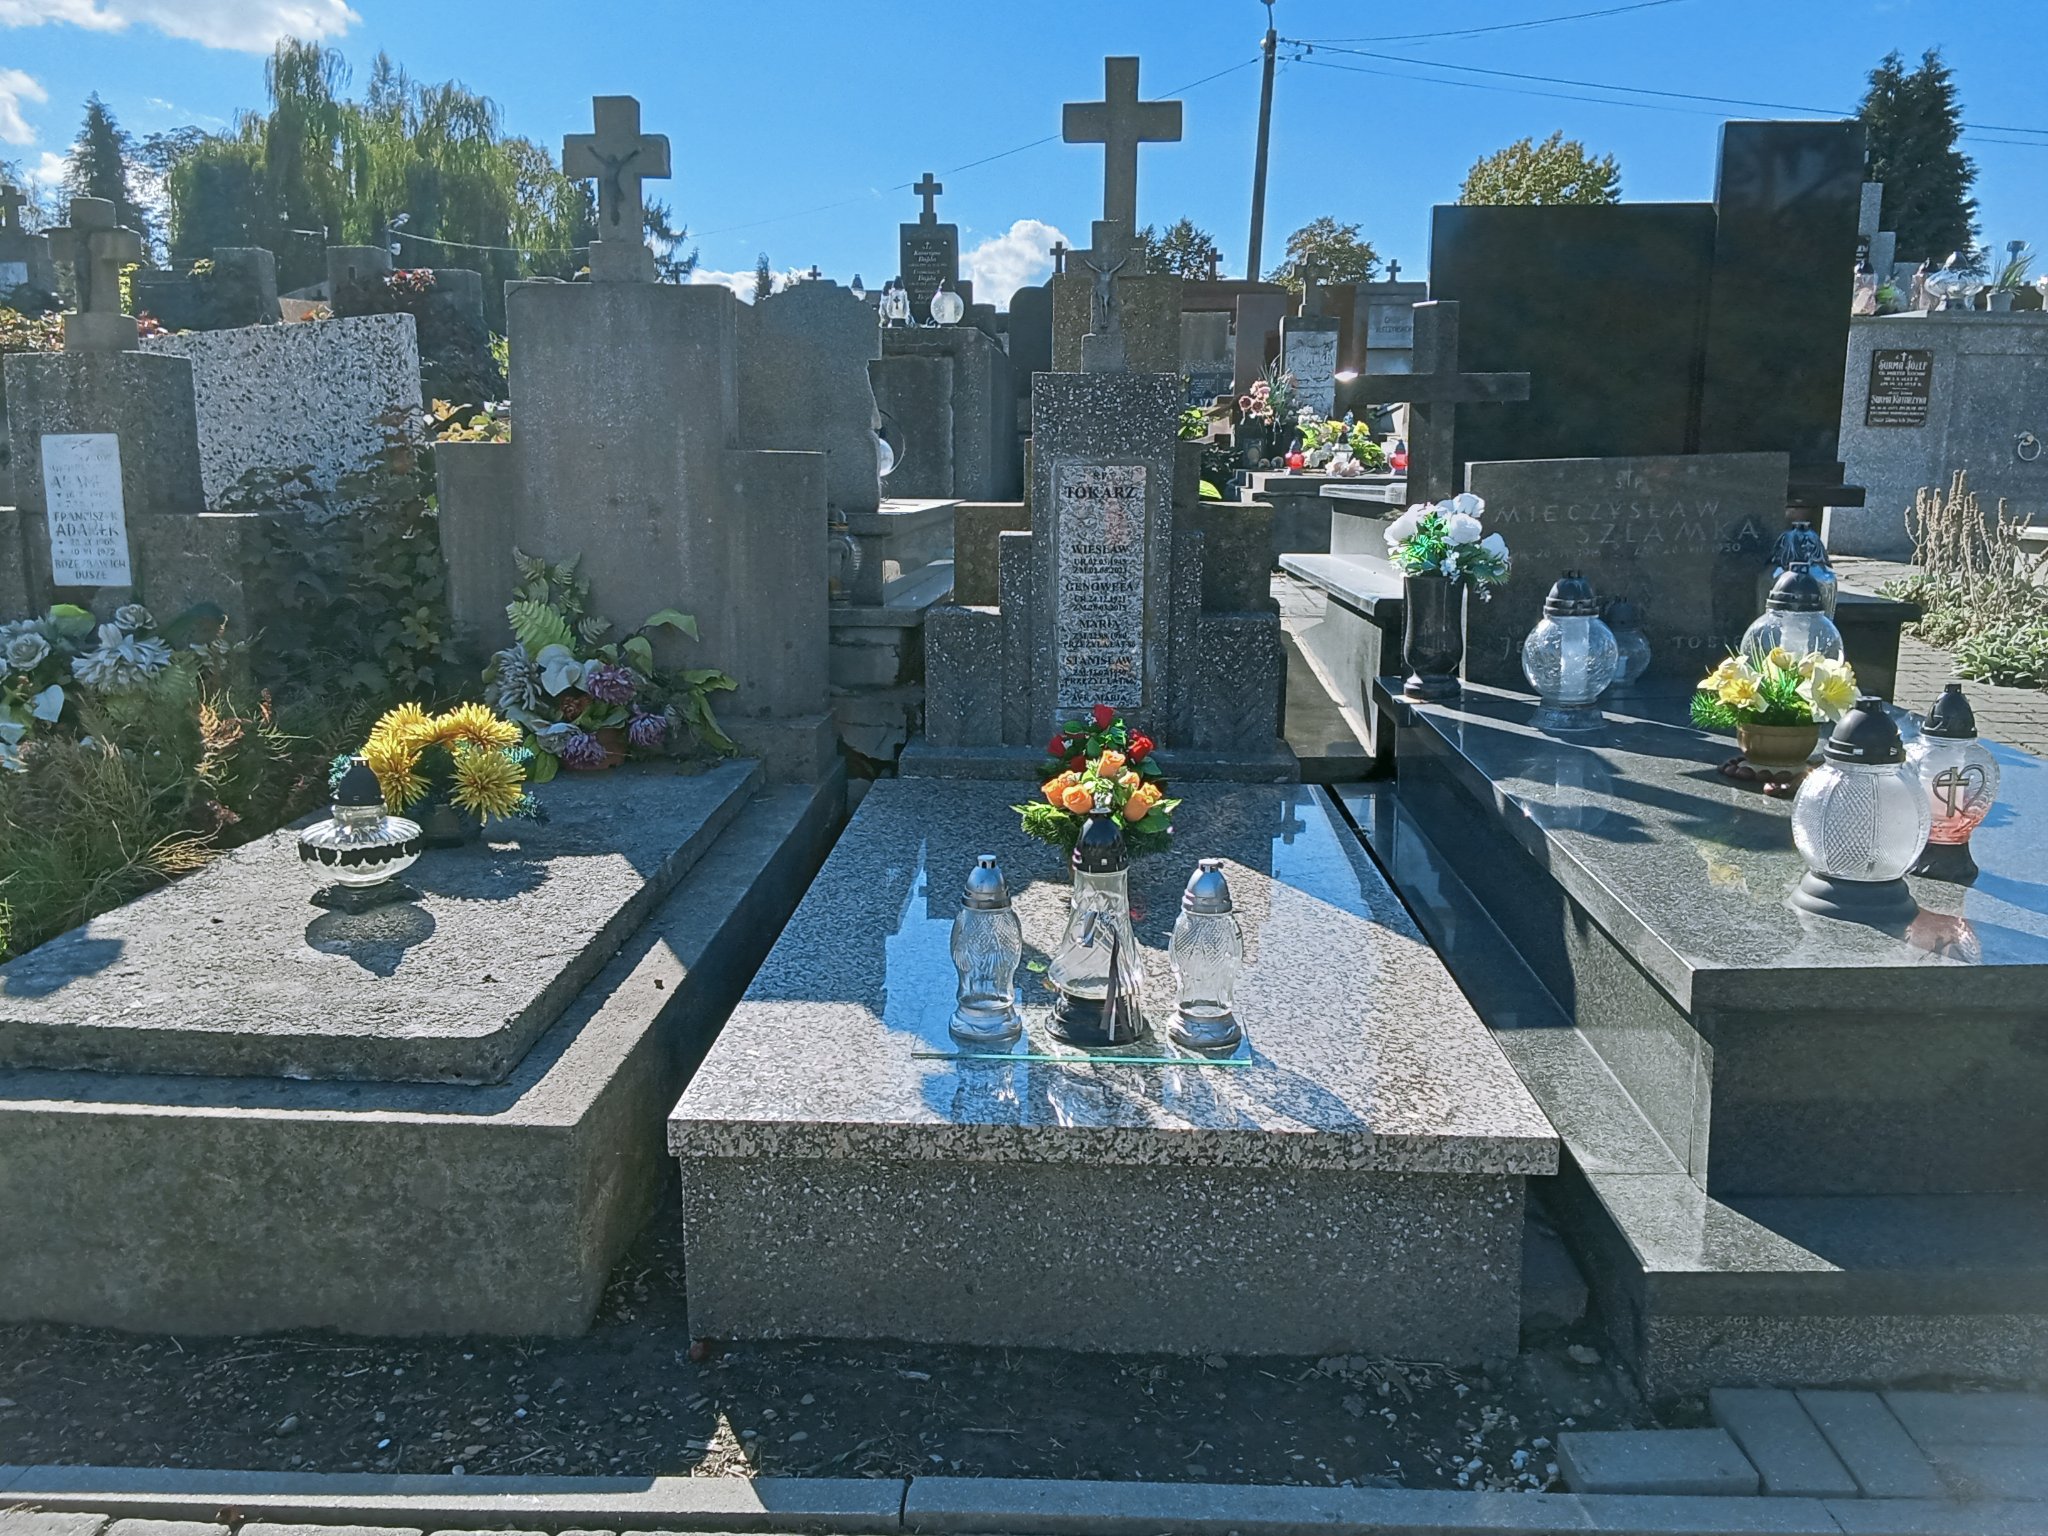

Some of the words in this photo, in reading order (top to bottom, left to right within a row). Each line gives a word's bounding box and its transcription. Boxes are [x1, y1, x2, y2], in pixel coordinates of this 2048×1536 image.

[1064, 486, 1139, 499] TOKARZ
[1495, 501, 1720, 522] MIECZYSŁAW
[1065, 581, 1134, 592] GENOWEFA
[1079, 619, 1122, 629] MARIA
